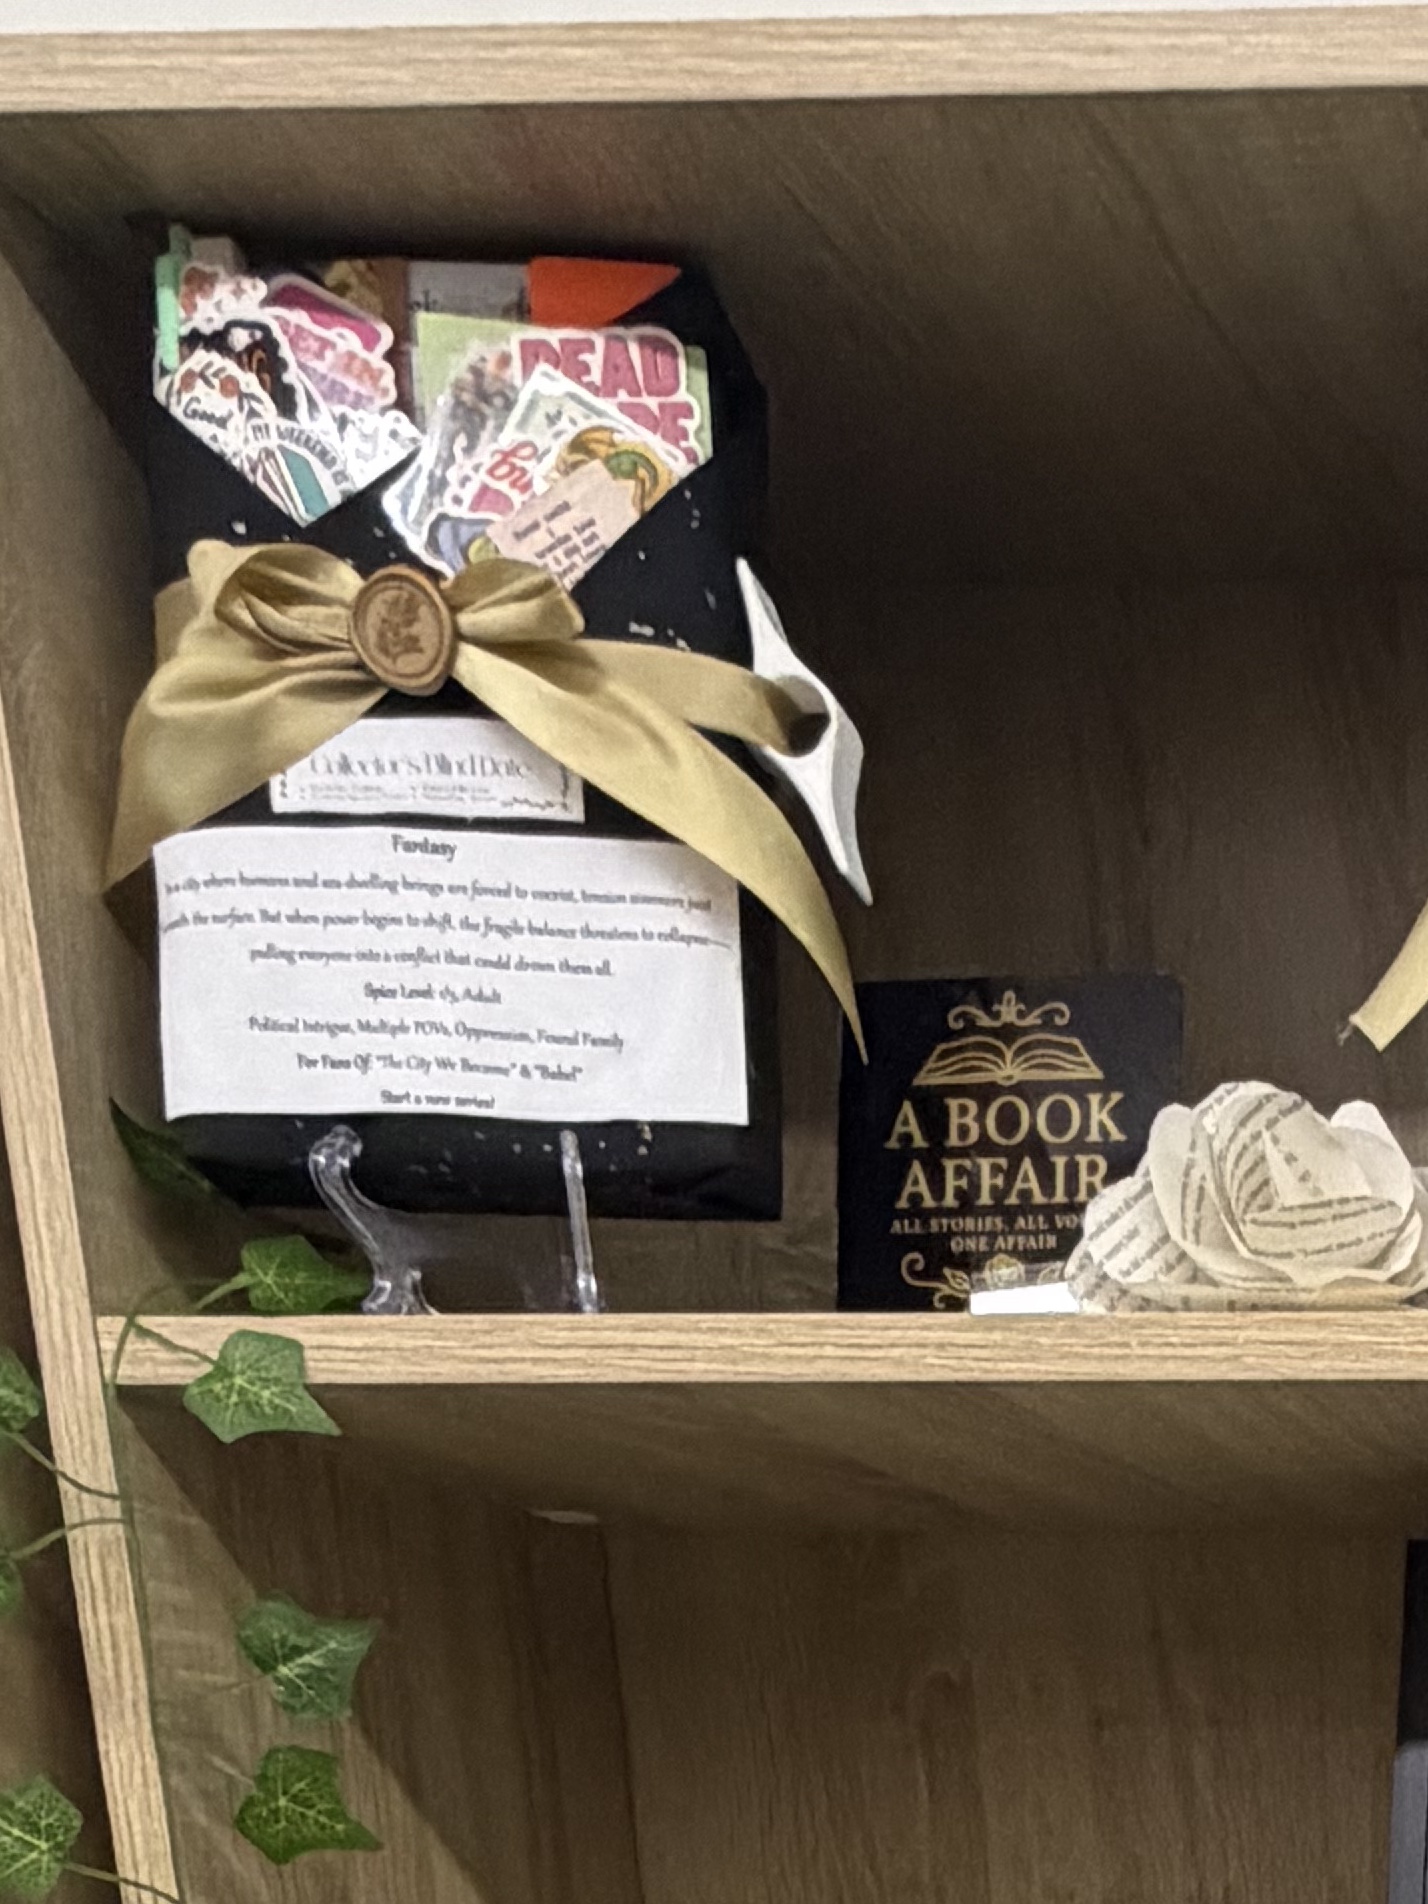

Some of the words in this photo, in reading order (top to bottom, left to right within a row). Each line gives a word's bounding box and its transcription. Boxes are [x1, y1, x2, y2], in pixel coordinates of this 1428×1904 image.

[884, 1101, 929, 1148] A
[945, 1092, 1128, 1148] BOOK
[895, 1155, 1108, 1209] AFFAIR
[890, 1219, 925, 1234] ALL
[930, 1216, 1008, 1232] STORIES,
[1014, 1216, 1048, 1230] ALL
[951, 1236, 988, 1251] ONE
[994, 1234, 1057, 1250] AFFAIR
